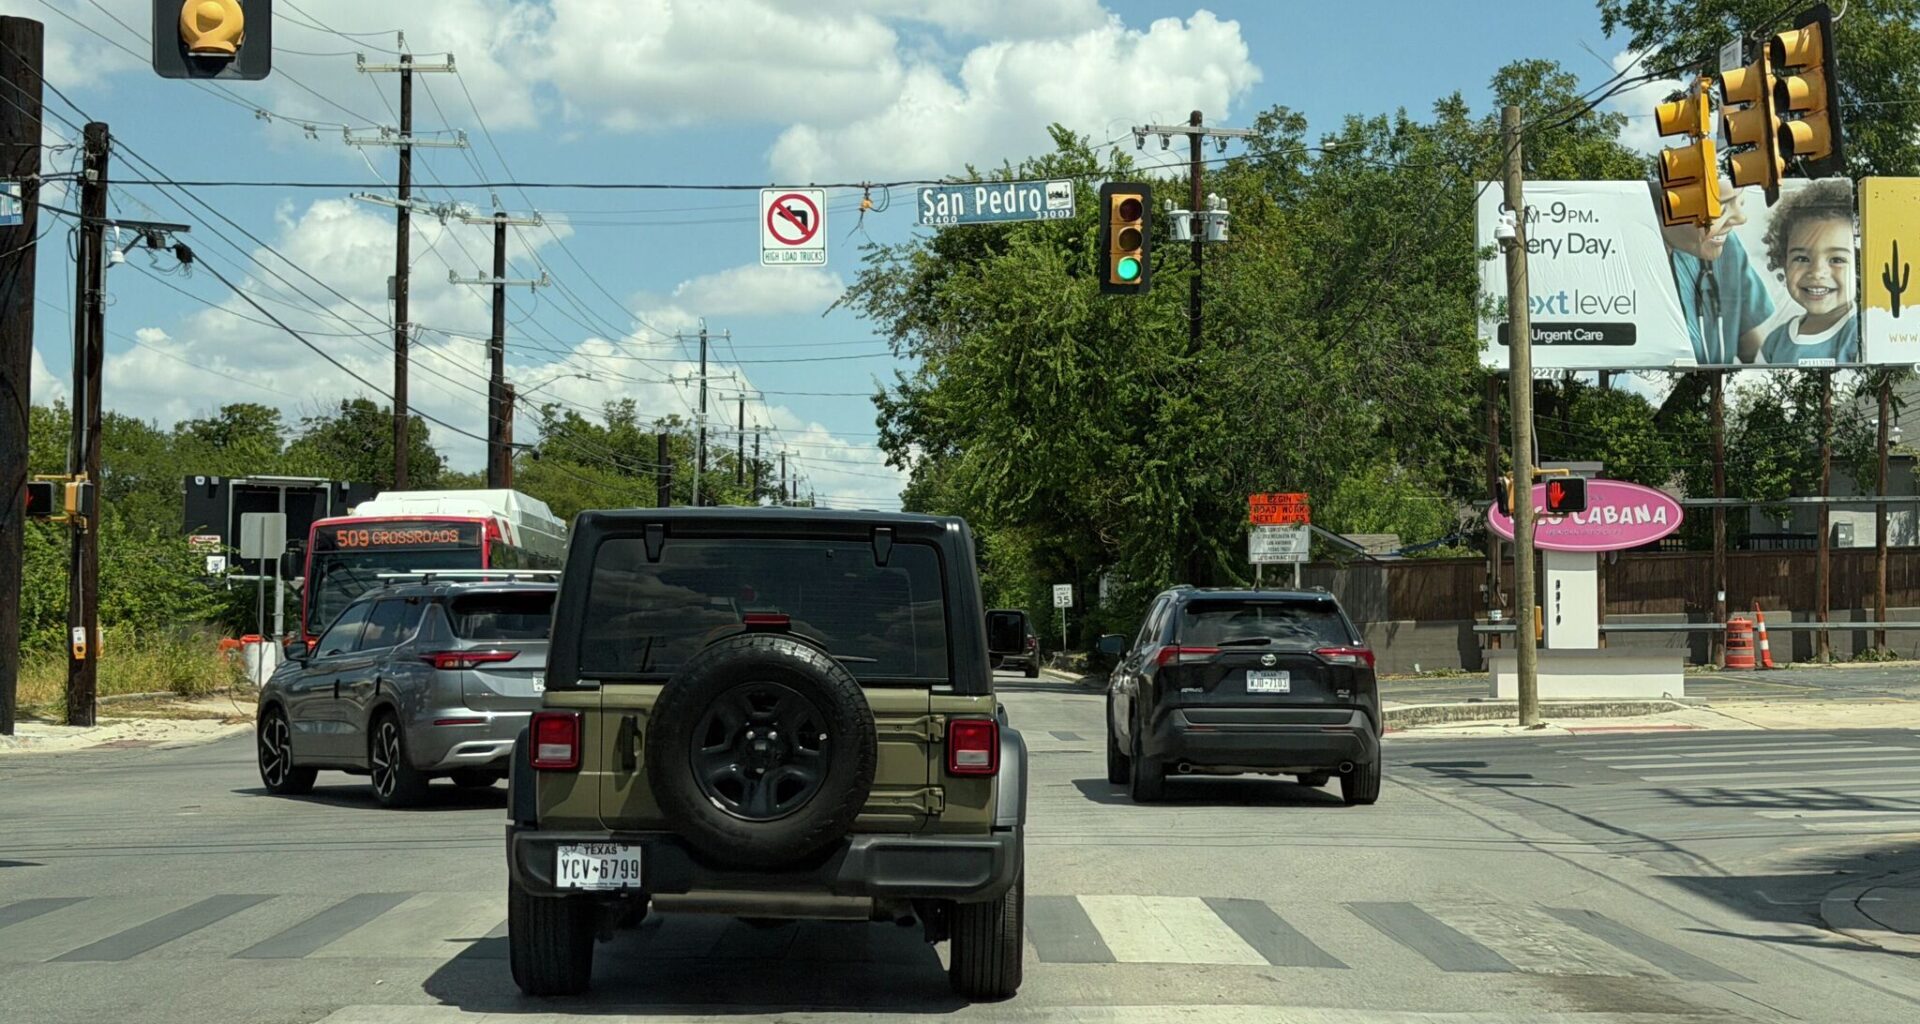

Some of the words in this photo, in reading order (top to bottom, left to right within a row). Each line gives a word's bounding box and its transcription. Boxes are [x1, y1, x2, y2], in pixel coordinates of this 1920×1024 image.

[922, 188, 964, 217] San
[975, 184, 1042, 215] Pedro
[1036, 209, 1064, 219] 3300
[929, 215, 958, 224] 3400
[1568, 232, 1616, 260] Day.
[765, 251, 779, 261] HIGH
[782, 251, 797, 261] LOAD
[799, 251, 823, 261] TRUCKS
[1575, 289, 1637, 315] level
[1531, 328, 1573, 344] Urgent
[1574, 328, 1604, 341] Care
[1253, 505, 1277, 514] ROAD
[1282, 505, 1305, 514] WORK
[1572, 503, 1668, 526] CABANA
[1253, 514, 1273, 522] NEXT
[1282, 514, 1306, 522] MILES
[336, 529, 369, 547] 509
[371, 529, 460, 545] CROSSROADS
[1056, 596, 1071, 605] 35
[584, 846, 618, 855] TEXAS
